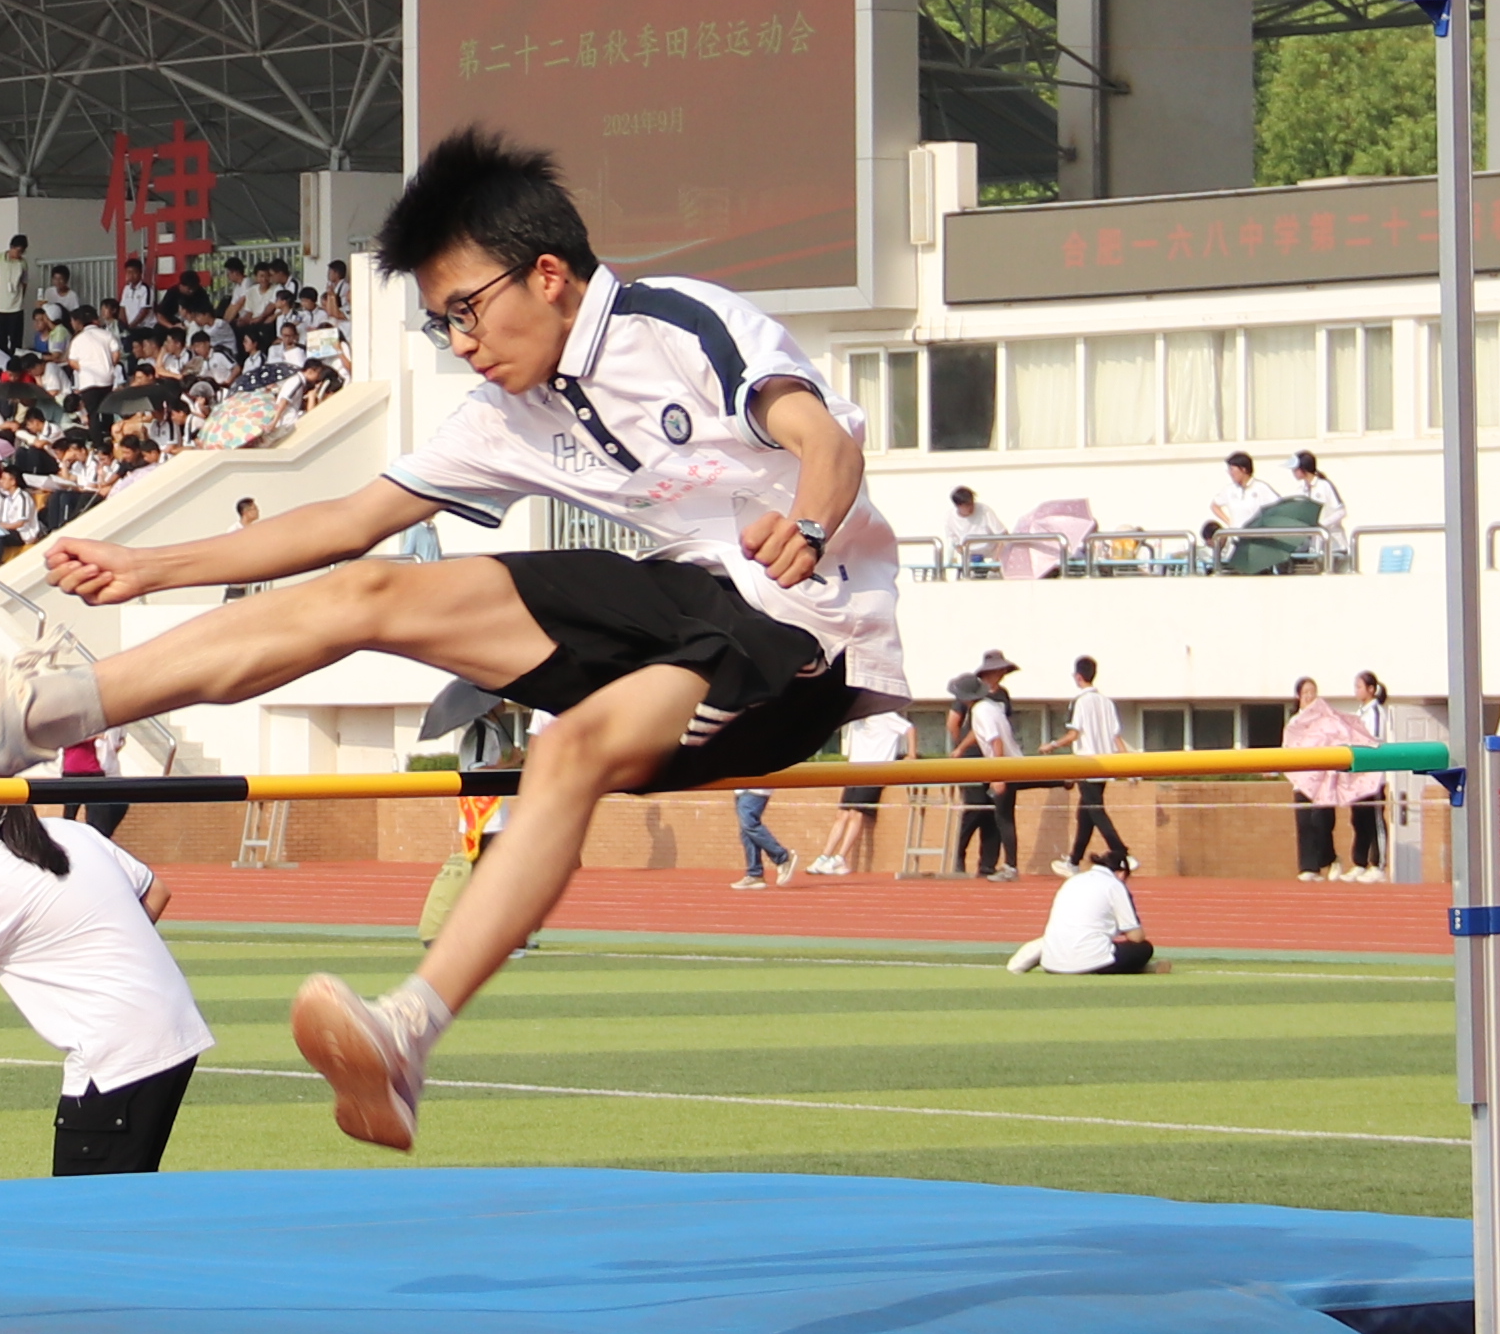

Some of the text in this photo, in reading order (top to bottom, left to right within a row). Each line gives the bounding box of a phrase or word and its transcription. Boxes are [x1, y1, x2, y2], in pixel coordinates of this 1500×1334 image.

[458, 10, 815, 80] 第二十二届秋季田径运动会
[602, 106, 683, 137] 2024年9月
